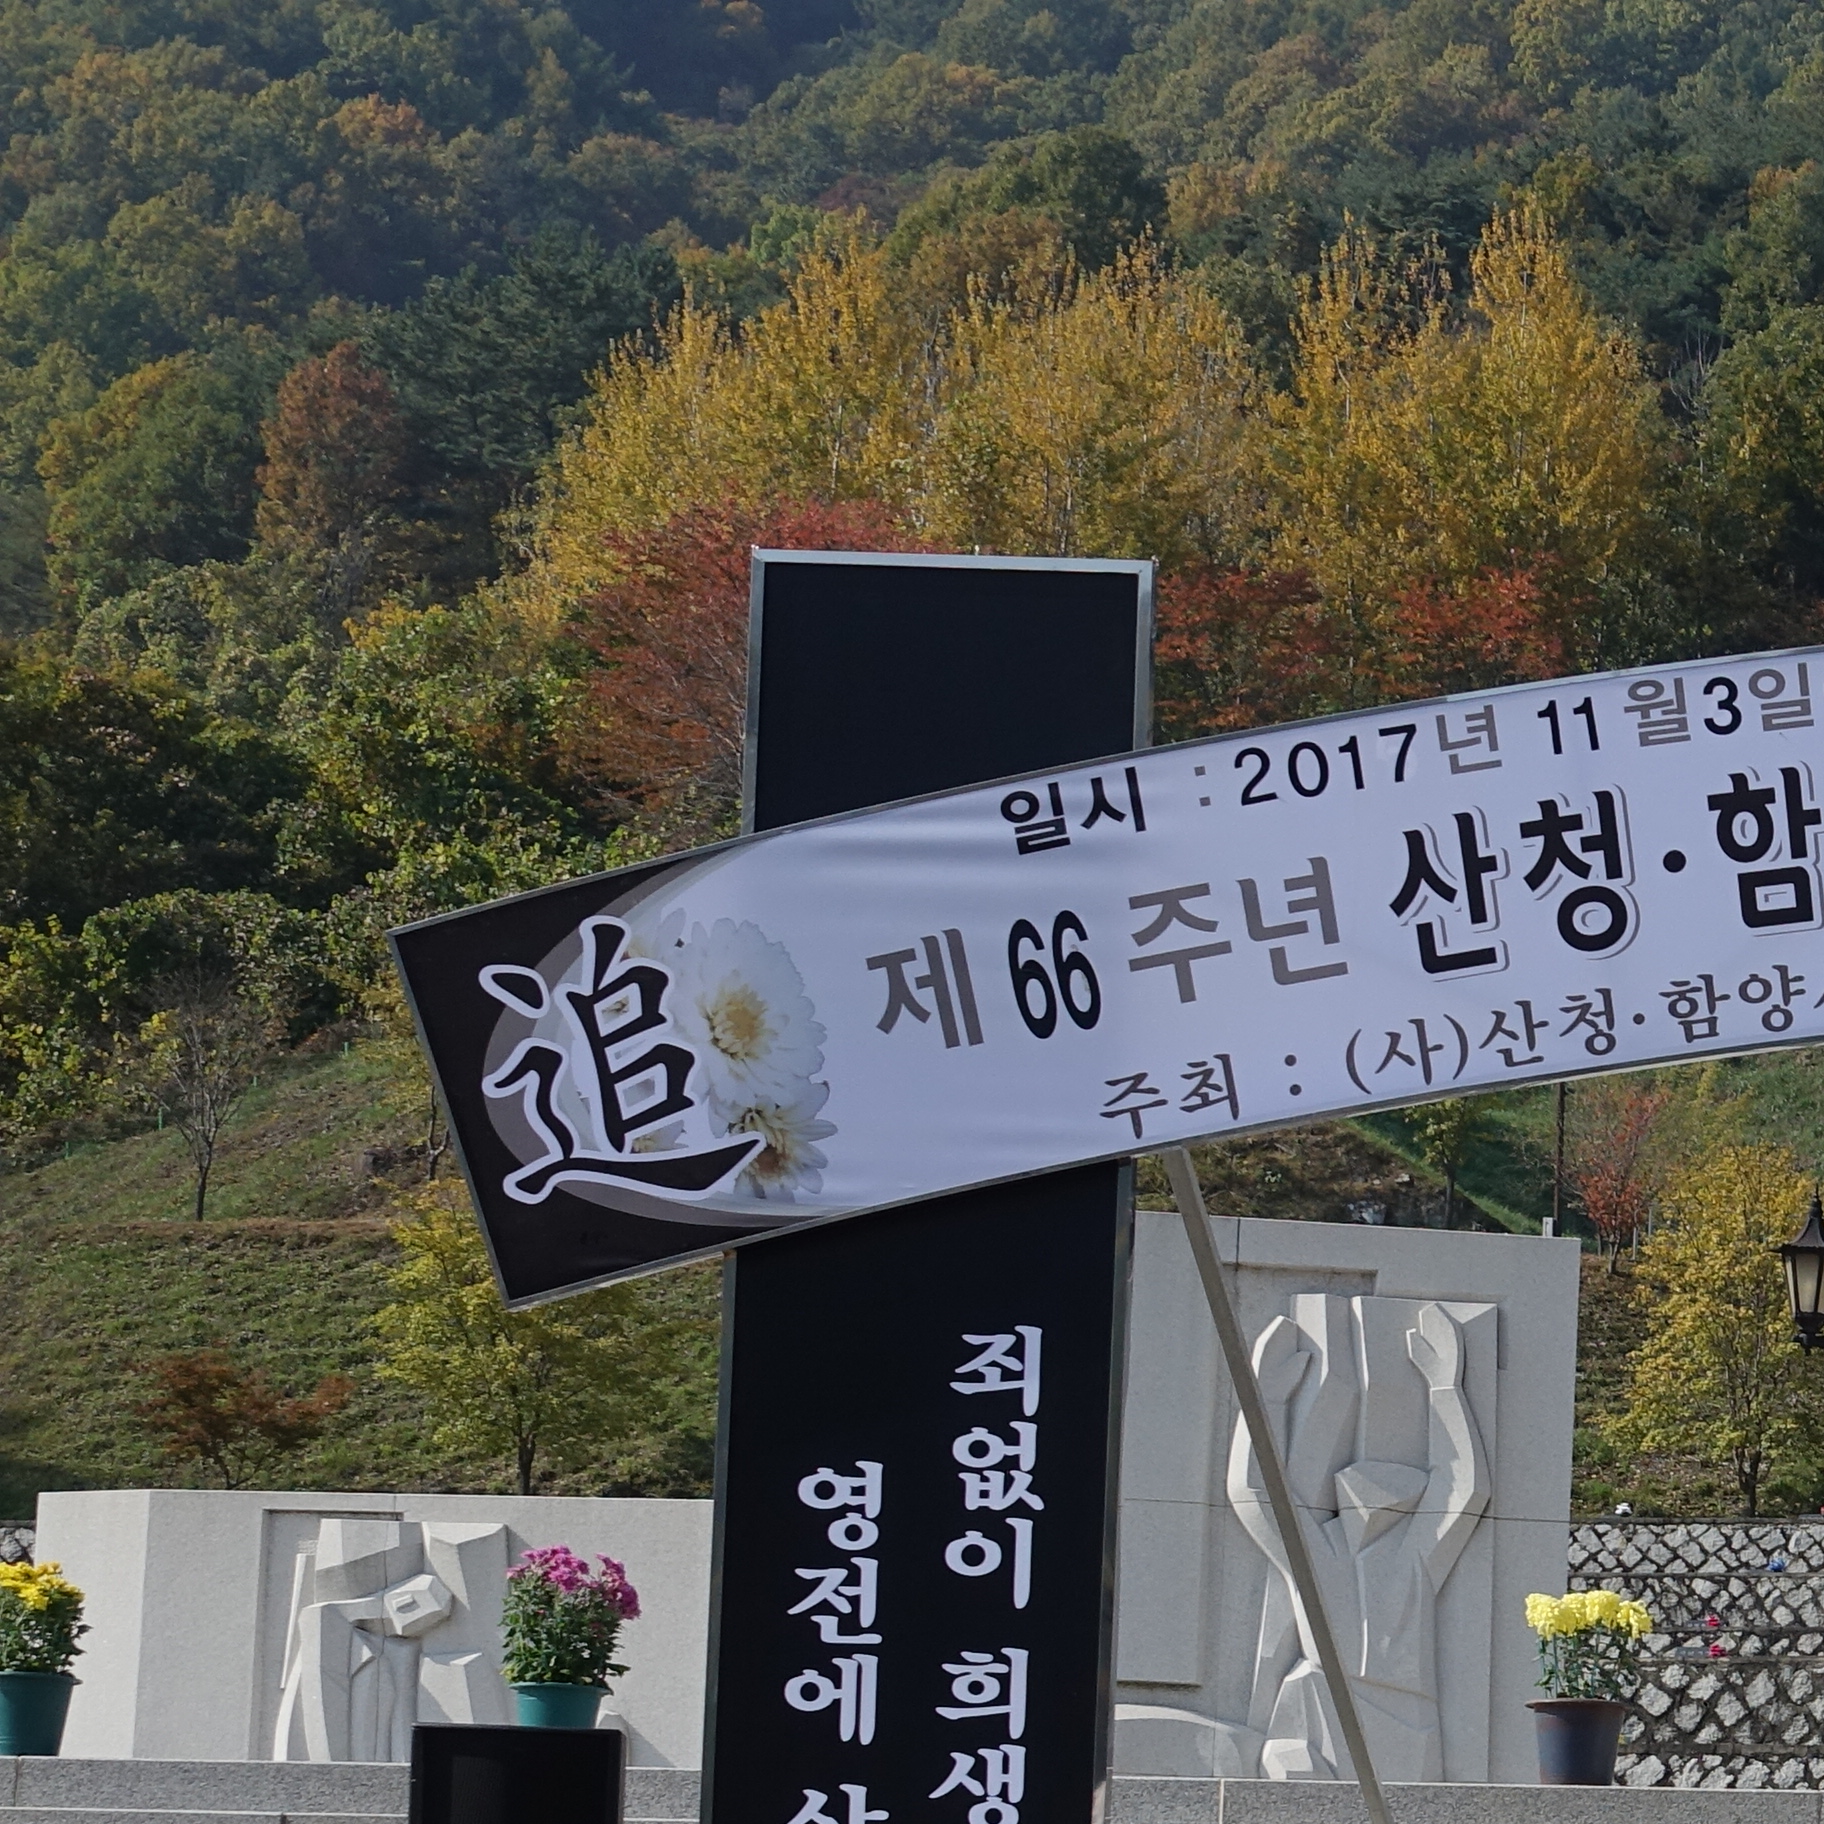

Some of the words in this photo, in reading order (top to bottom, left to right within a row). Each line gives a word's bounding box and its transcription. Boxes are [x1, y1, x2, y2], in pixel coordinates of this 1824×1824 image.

[998, 765, 1148, 855] 일시
[1233, 703, 1503, 806] 2017년
[478, 915, 766, 1204] 追
[1097, 1051, 1243, 1139] 주최
[784, 1460, 884, 1746] 영전에
[945, 1325, 1045, 1610] 죄없이
